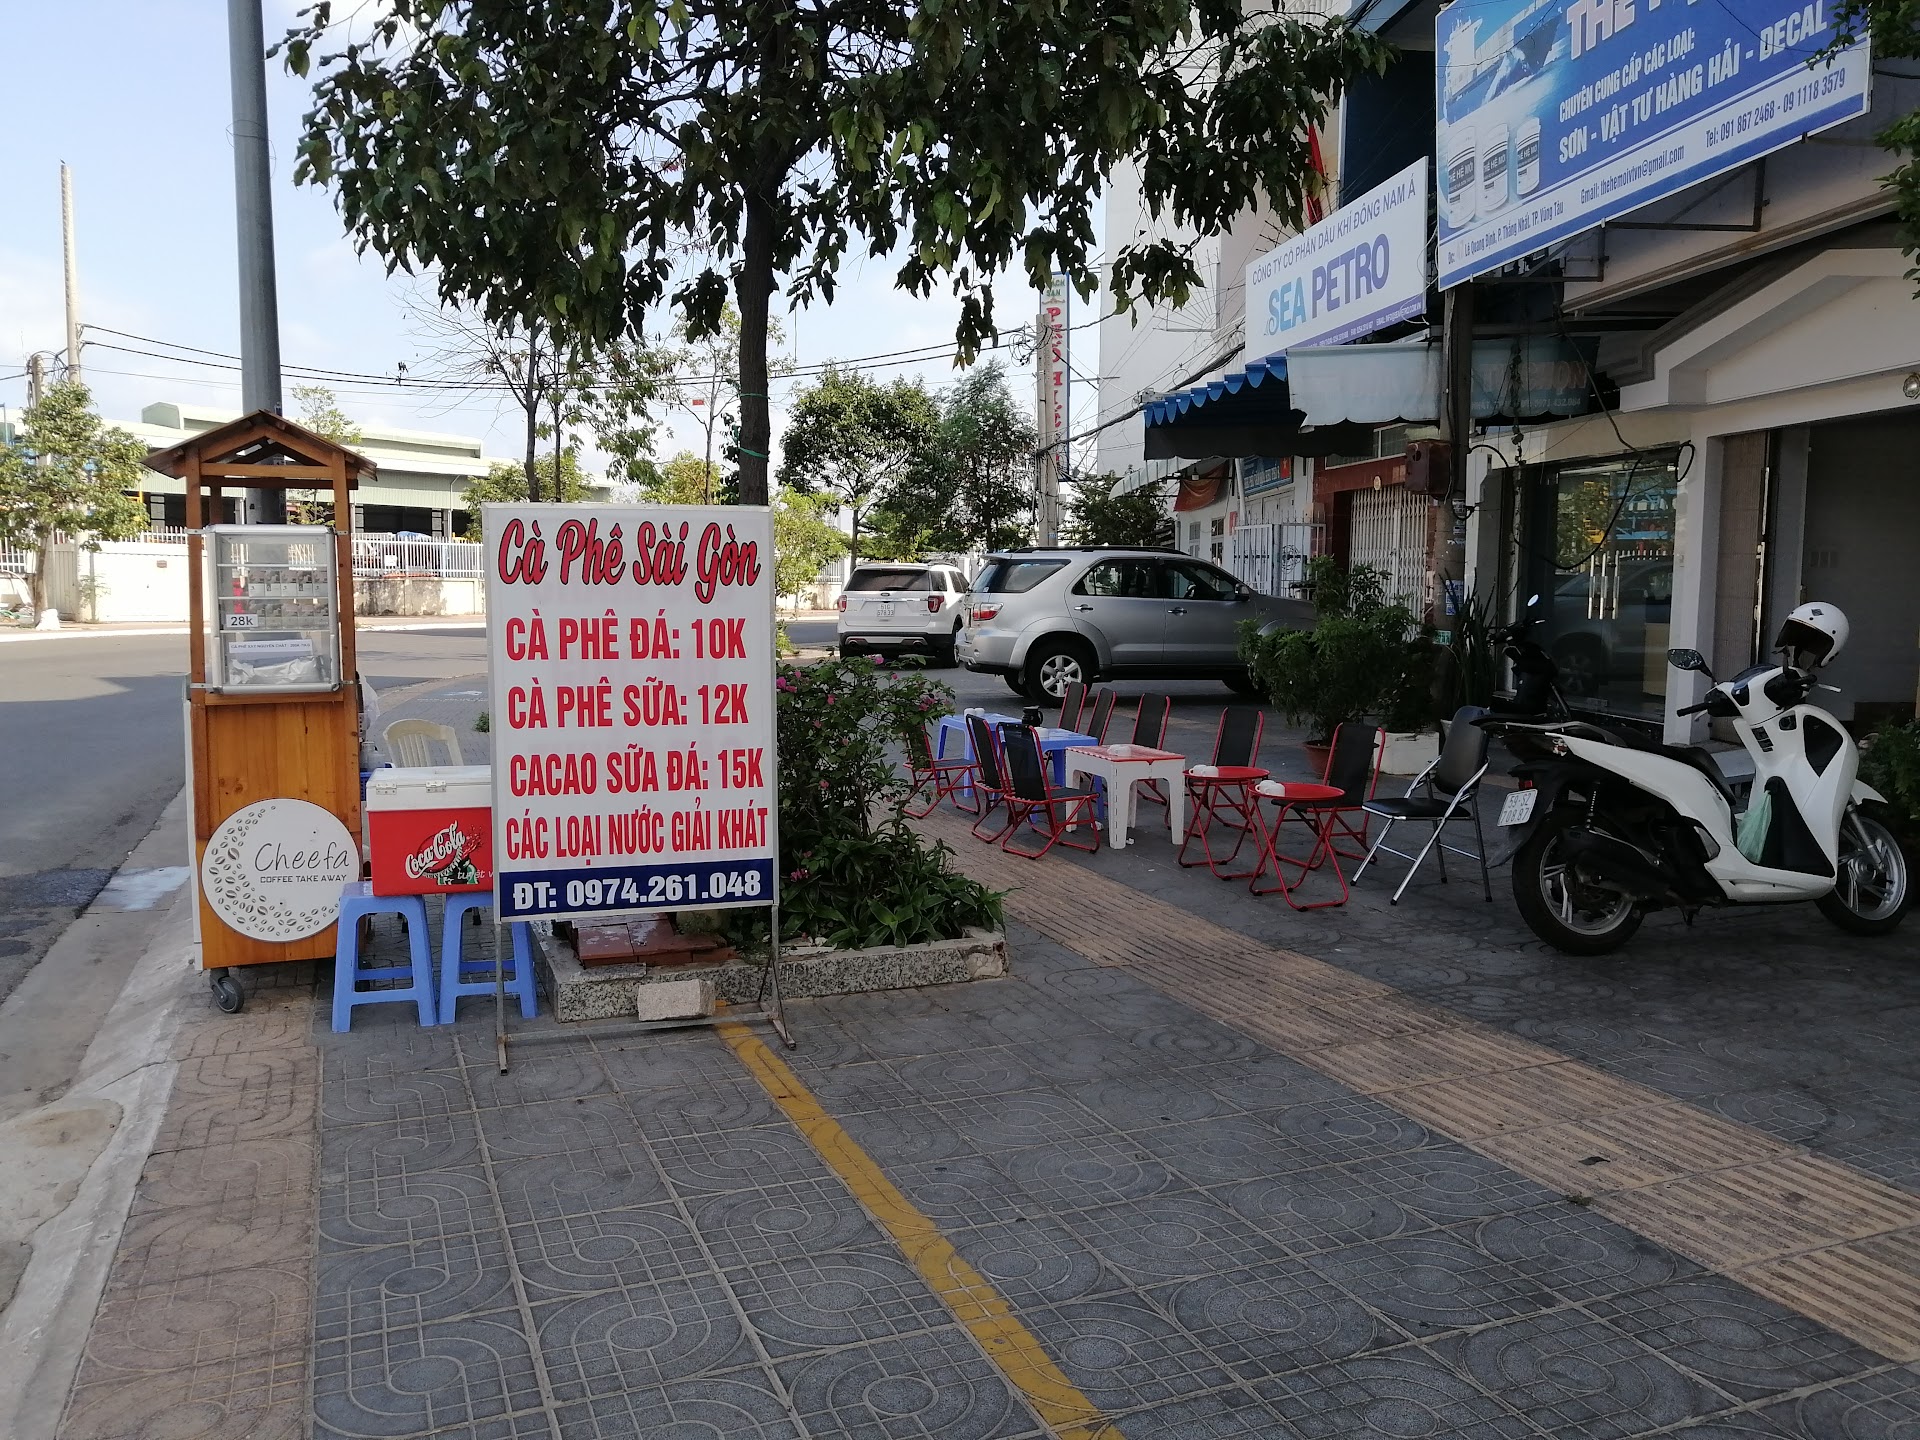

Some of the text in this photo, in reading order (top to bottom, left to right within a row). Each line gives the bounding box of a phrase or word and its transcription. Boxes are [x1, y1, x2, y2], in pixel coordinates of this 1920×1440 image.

[1559, 27, 1695, 122] CHUYÊN CUNG CẤP CÁC LOẠI:
[1559, 125, 1588, 164] SƠN
[1600, 103, 1629, 143] VẬT
[1631, 87, 1654, 126] TƯ
[1655, 64, 1703, 115] HÀNG
[1707, 38, 1741, 88] HẢI
[1759, 0, 1827, 62] DECAL
[1706, 127, 1719, 148] Tel:
[1720, 121, 1734, 142] 091
[1737, 113, 1752, 134] 867
[1754, 100, 1775, 126] 2468
[1783, 93, 1794, 113] 09
[1797, 83, 1819, 107] 1118
[1821, 67, 1846, 96] 3579
[1580, 184, 1600, 204] Gmail:
[1252, 264, 1272, 286] CÔNG
[1273, 258, 1282, 274] TY
[1295, 236, 1316, 261] PHẦN
[1318, 229, 1335, 250] DẦU
[1337, 214, 1352, 239] KHÍ
[1353, 201, 1381, 230] ĐÔNG
[1382, 184, 1405, 213] NAM
[1407, 173, 1416, 199] Á
[1464, 243, 1471, 257] Lê
[1470, 237, 1485, 256] Quang
[1539, 206, 1553, 223] Vũng
[1553, 200, 1564, 217] Tàu
[1268, 233, 1390, 335] SEA PETRO
[498, 518, 762, 604] Cà Phê Sài Gòn
[231, 615, 254, 626] 28k
[505, 608, 747, 661] CÀ PHÊ ĐÁ: 10K
[507, 675, 749, 729] CÀ PHÊ SỮA: 12K
[509, 741, 764, 797] CACAO SỮA ĐÁ: 15K
[254, 841, 350, 872] Cheefa
[506, 797, 768, 866] CÁC LOẠI NƯỚC GIẢI KHÁT
[260, 874, 347, 883] COFFEE TAKE AWAY
[512, 870, 761, 910] ĐT: 0974.261.048
